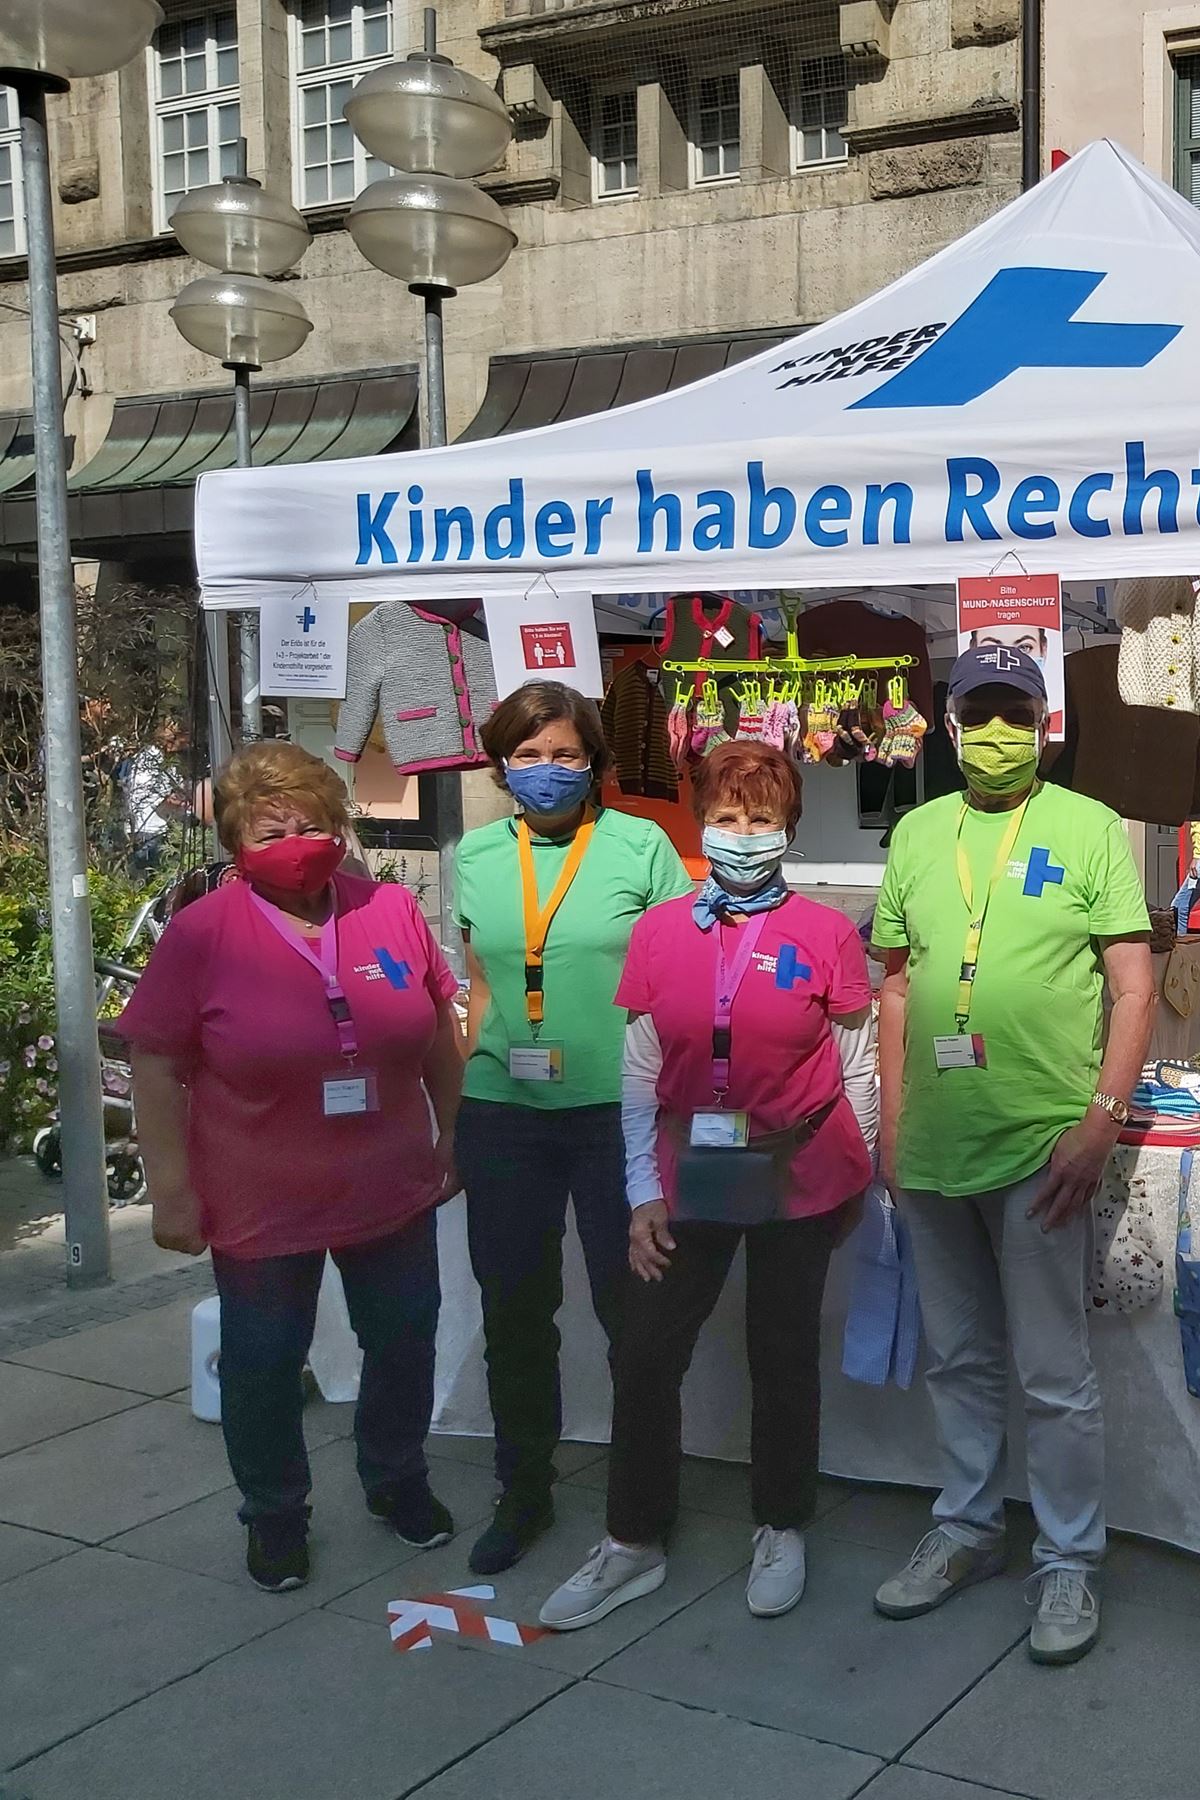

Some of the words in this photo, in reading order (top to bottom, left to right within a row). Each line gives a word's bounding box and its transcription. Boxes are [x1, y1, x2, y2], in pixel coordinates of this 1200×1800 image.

[768, 322, 948, 374] KINDER
[824, 338, 936, 371] NOT
[775, 354, 916, 391] HILFE
[355, 478, 613, 566] Kinder
[636, 461, 913, 554] haben
[1000, 586, 1017, 595] Bitte
[962, 598, 1056, 609] MUND-/NASENSCHUTZ
[997, 611, 1020, 621] tragen
[752, 951, 778, 962] kinder
[353, 961, 381, 973] kinder
[757, 964, 776, 974] hilfe
[763, 960, 777, 968] not
[365, 972, 386, 982] hilfe
[368, 968, 384, 976] not
[72, 1246, 80, 1264] 9
